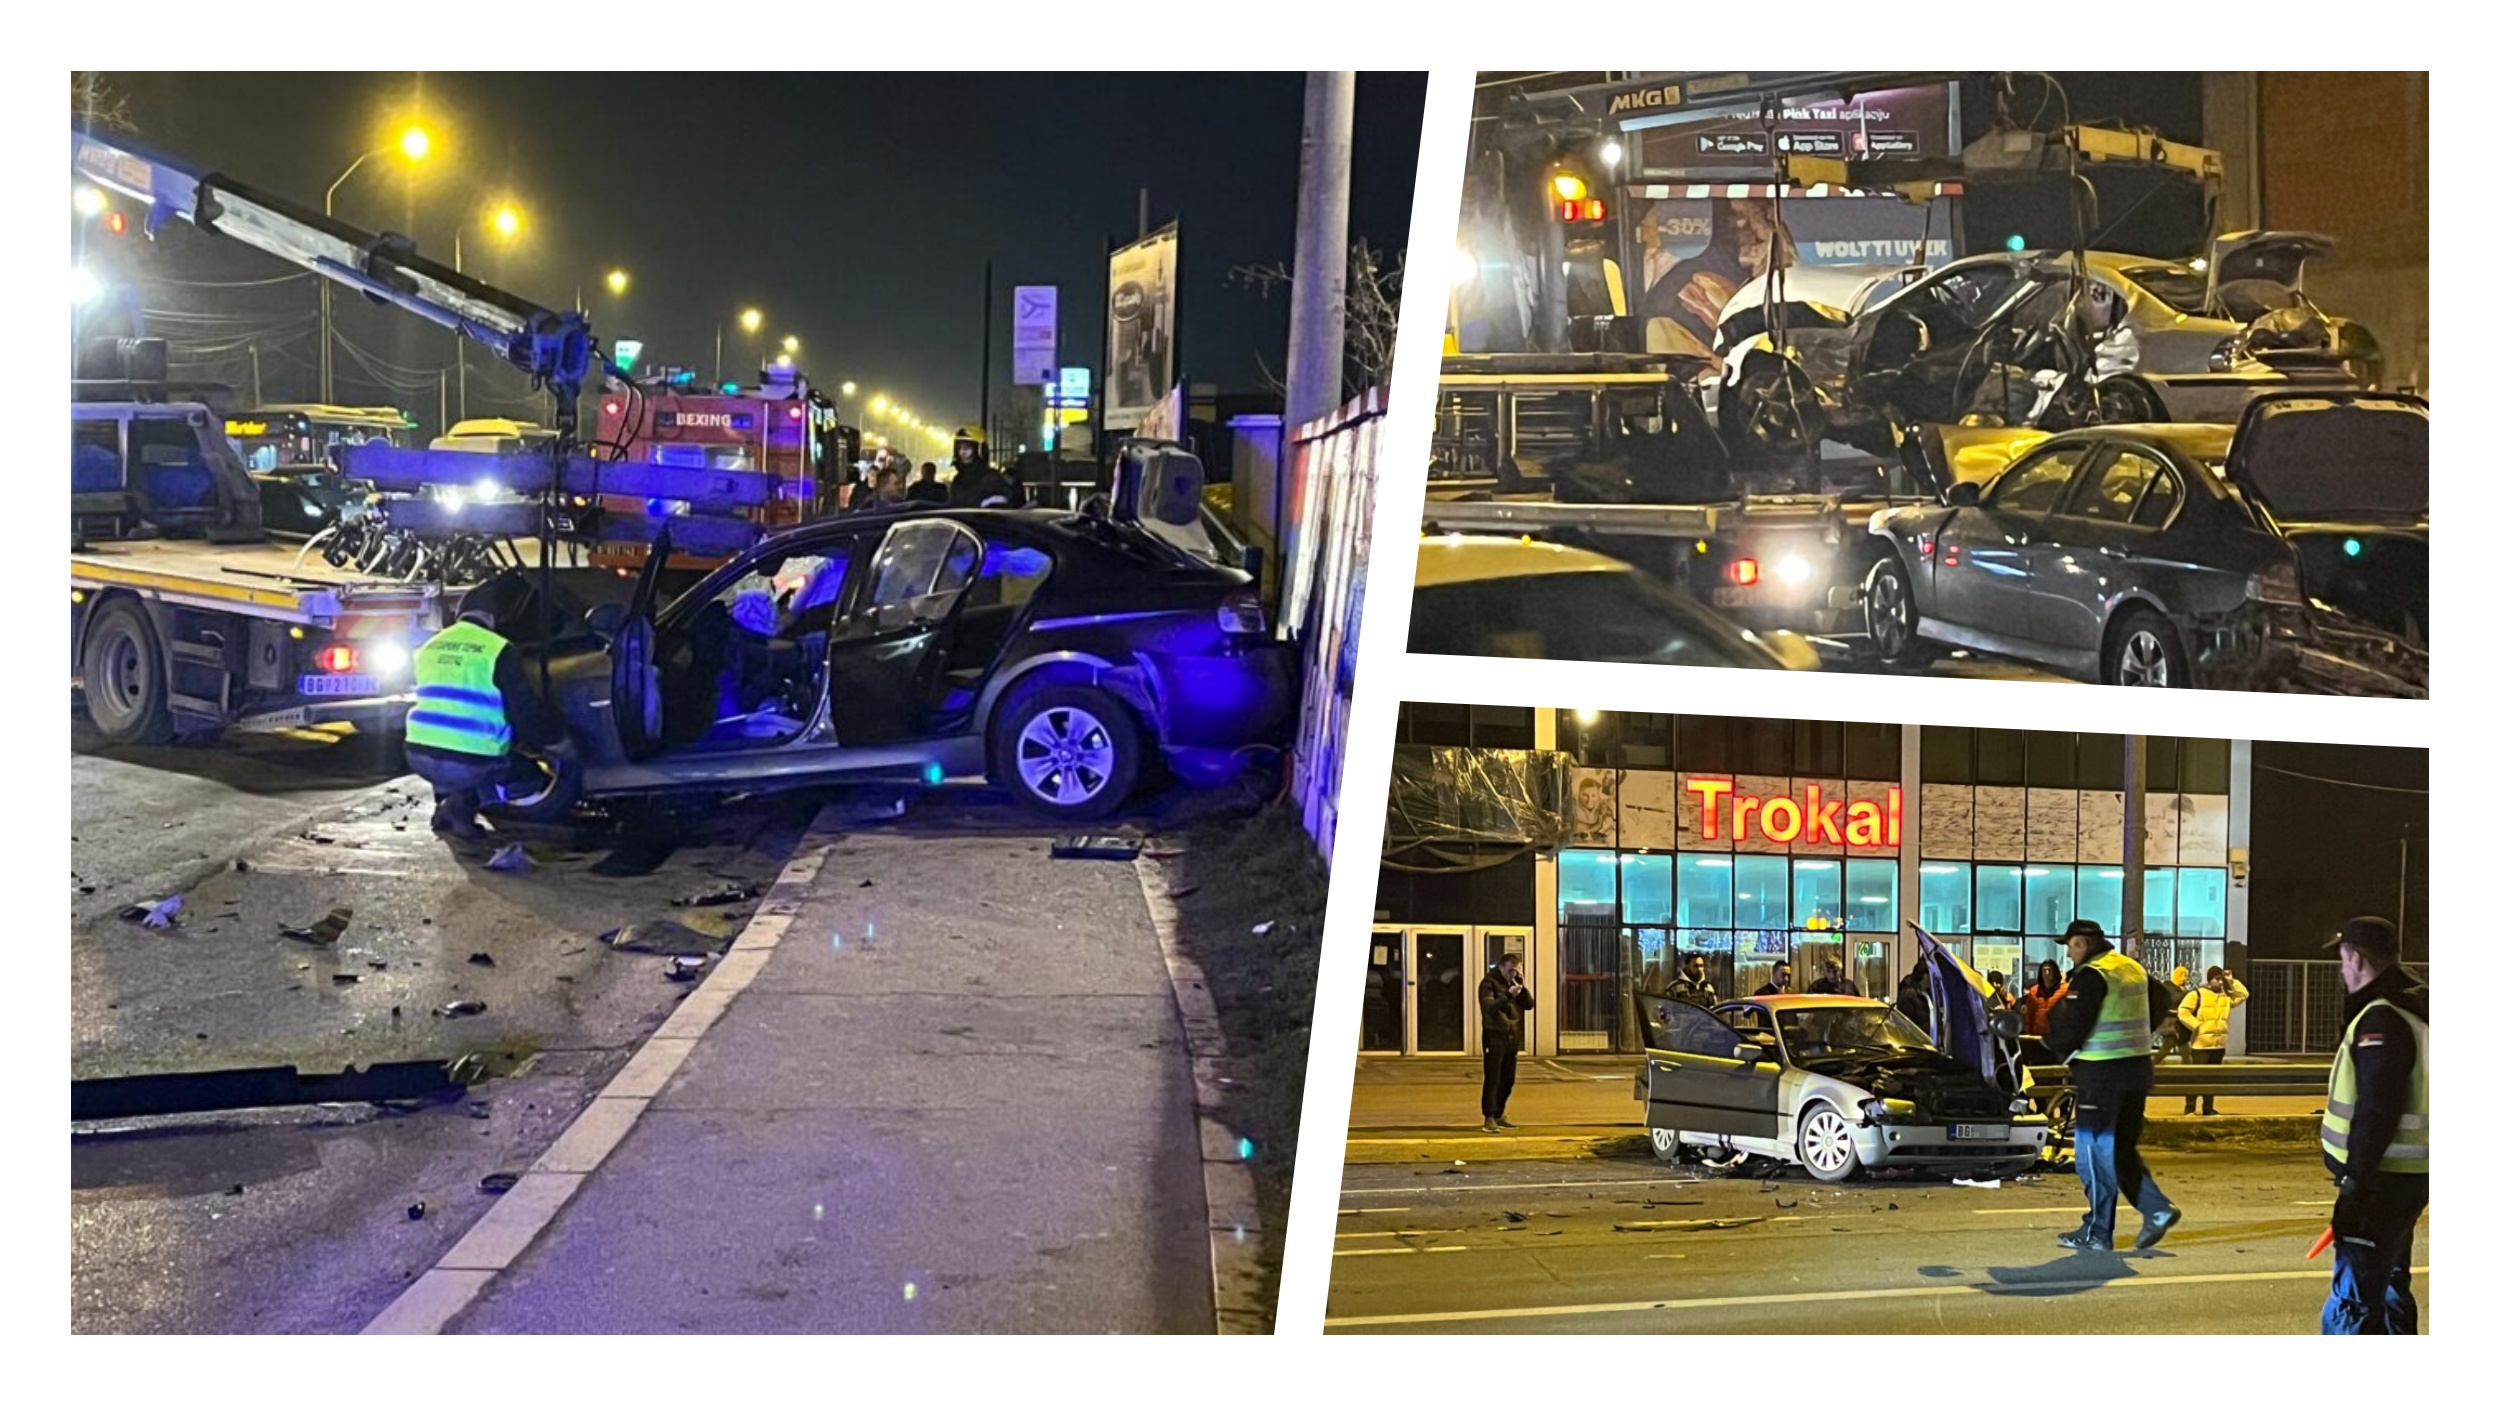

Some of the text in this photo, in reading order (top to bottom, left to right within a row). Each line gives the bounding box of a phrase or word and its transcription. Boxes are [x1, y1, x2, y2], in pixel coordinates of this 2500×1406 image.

[1609, 89, 1662, 115] MKG
[1783, 108, 1809, 120] Pink
[1812, 109, 1837, 120] Taxi
[1717, 141, 1765, 152] Google Play
[1793, 140, 1839, 151] App Store
[1815, 240, 1870, 258] WOLT
[676, 412, 732, 428] BEXING
[1687, 778, 1902, 846] Trokal
